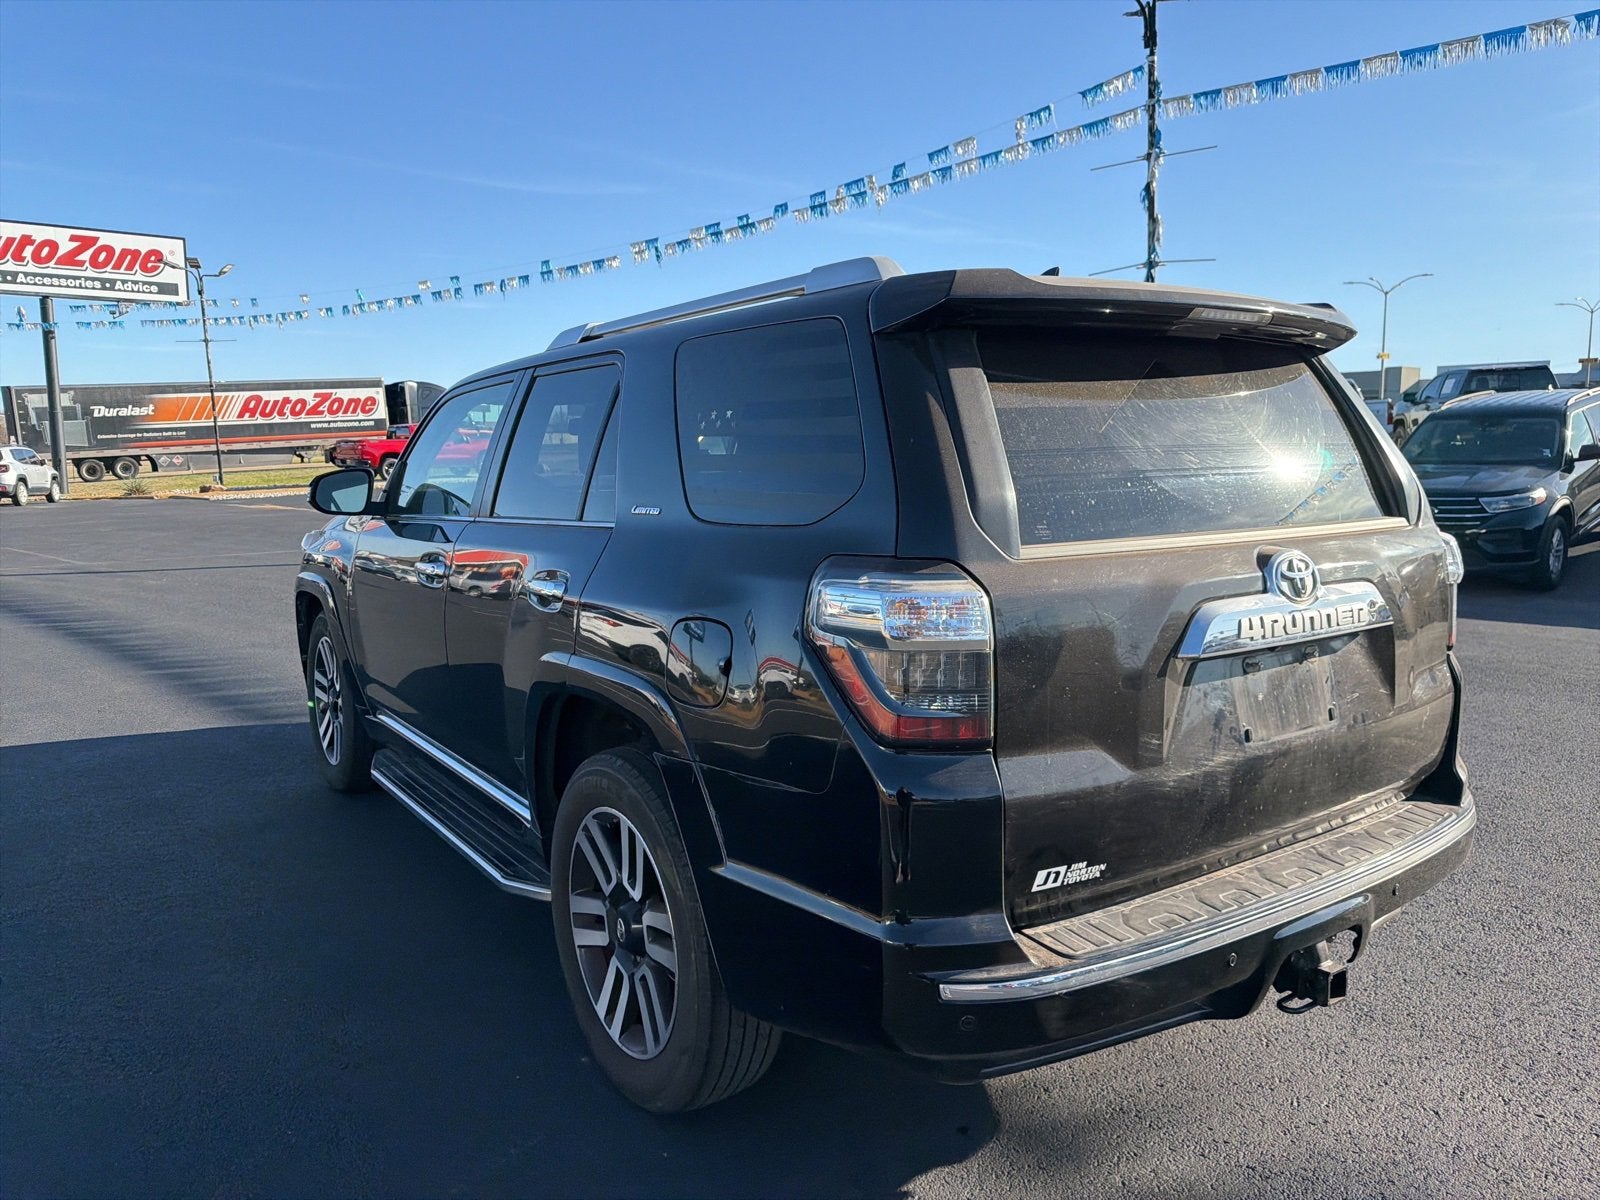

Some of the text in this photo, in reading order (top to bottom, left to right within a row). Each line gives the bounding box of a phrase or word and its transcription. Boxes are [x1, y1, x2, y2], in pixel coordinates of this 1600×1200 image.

[16, 272, 159, 293] Accessories Advice
[90, 404, 155, 418] Duralast
[236, 391, 377, 419] AutoZone
[310, 420, 375, 429] www.autozone.com
[1238, 602, 1370, 641] 4RUNNER
[1065, 863, 1107, 879] NORTON
[1068, 861, 1088, 872] JIM
[1063, 871, 1101, 885] TOYOTA
